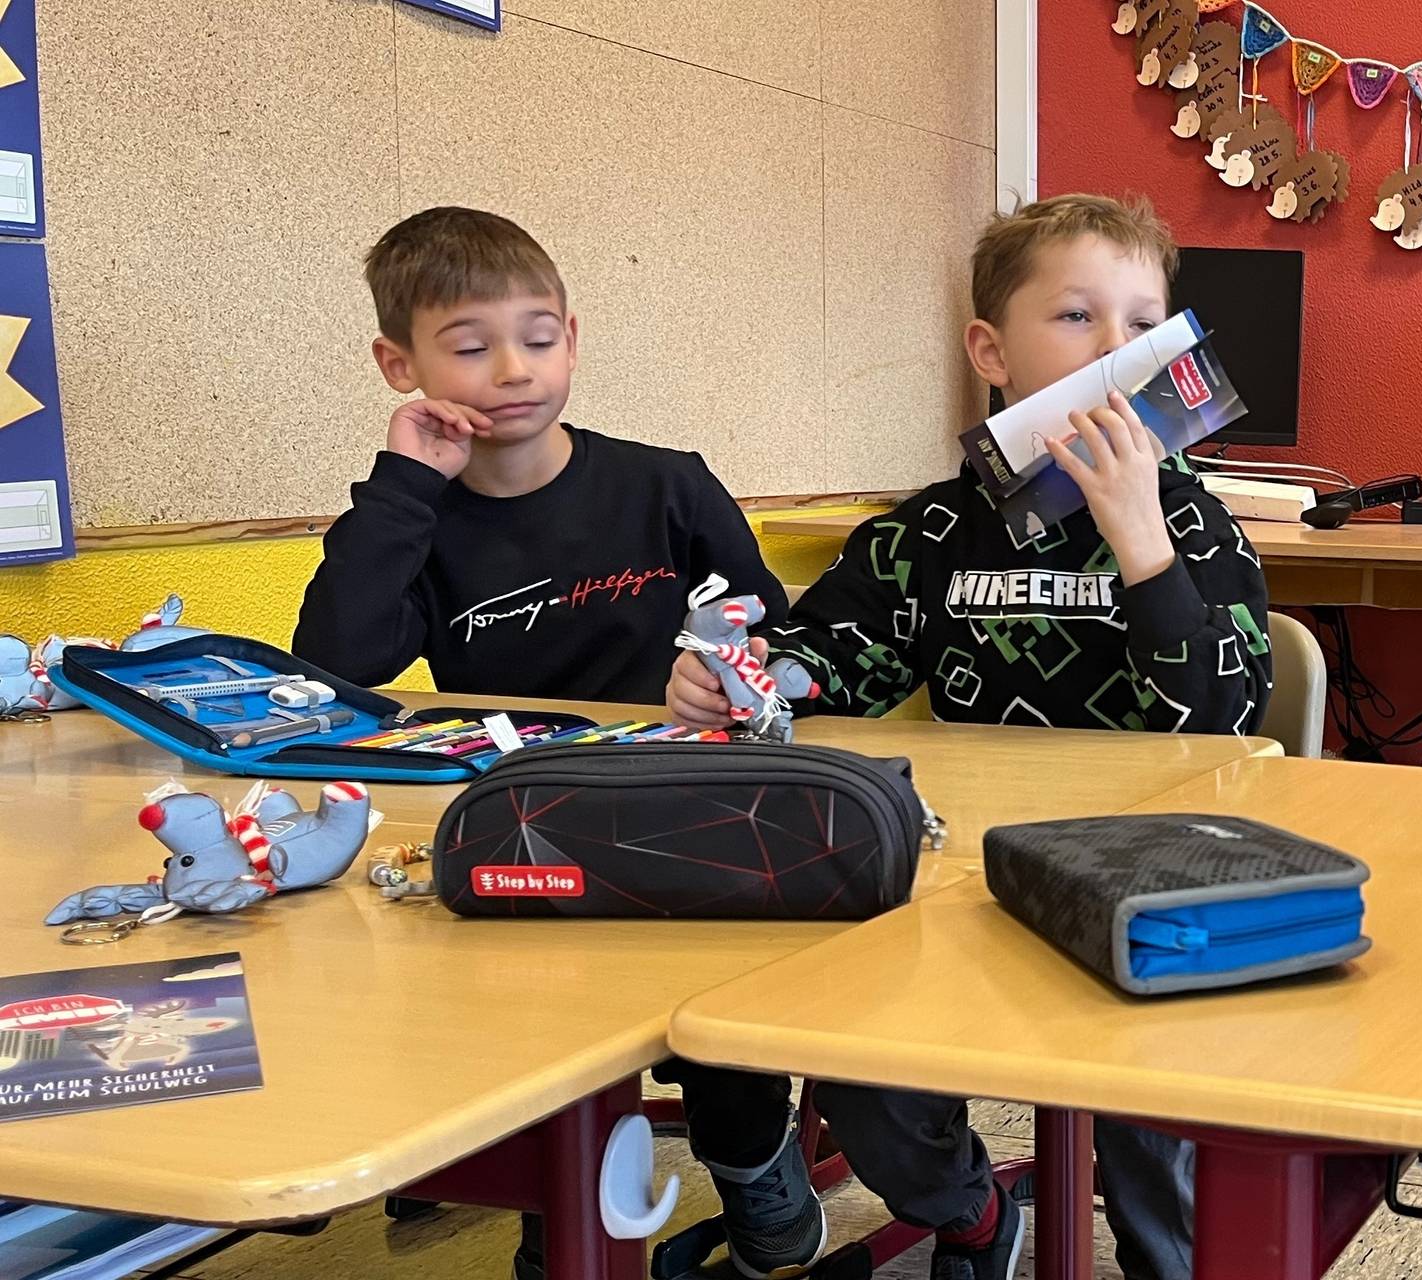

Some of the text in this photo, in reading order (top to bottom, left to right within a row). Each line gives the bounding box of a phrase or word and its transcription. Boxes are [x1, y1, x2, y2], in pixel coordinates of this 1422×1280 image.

[1249, 137, 1279, 155] Malou
[1293, 165, 1316, 185] Linus
[450, 567, 677, 643] Tommy Hilfiger
[496, 873, 576, 890] Step by Step
[14, 1000, 85, 1016] ICH BIN
[34, 1078, 94, 1092] MEHR
[102, 1064, 216, 1085] SICHERHEIT
[43, 1089, 90, 1101] DEM
[100, 1075, 208, 1096] SCHULWEG
